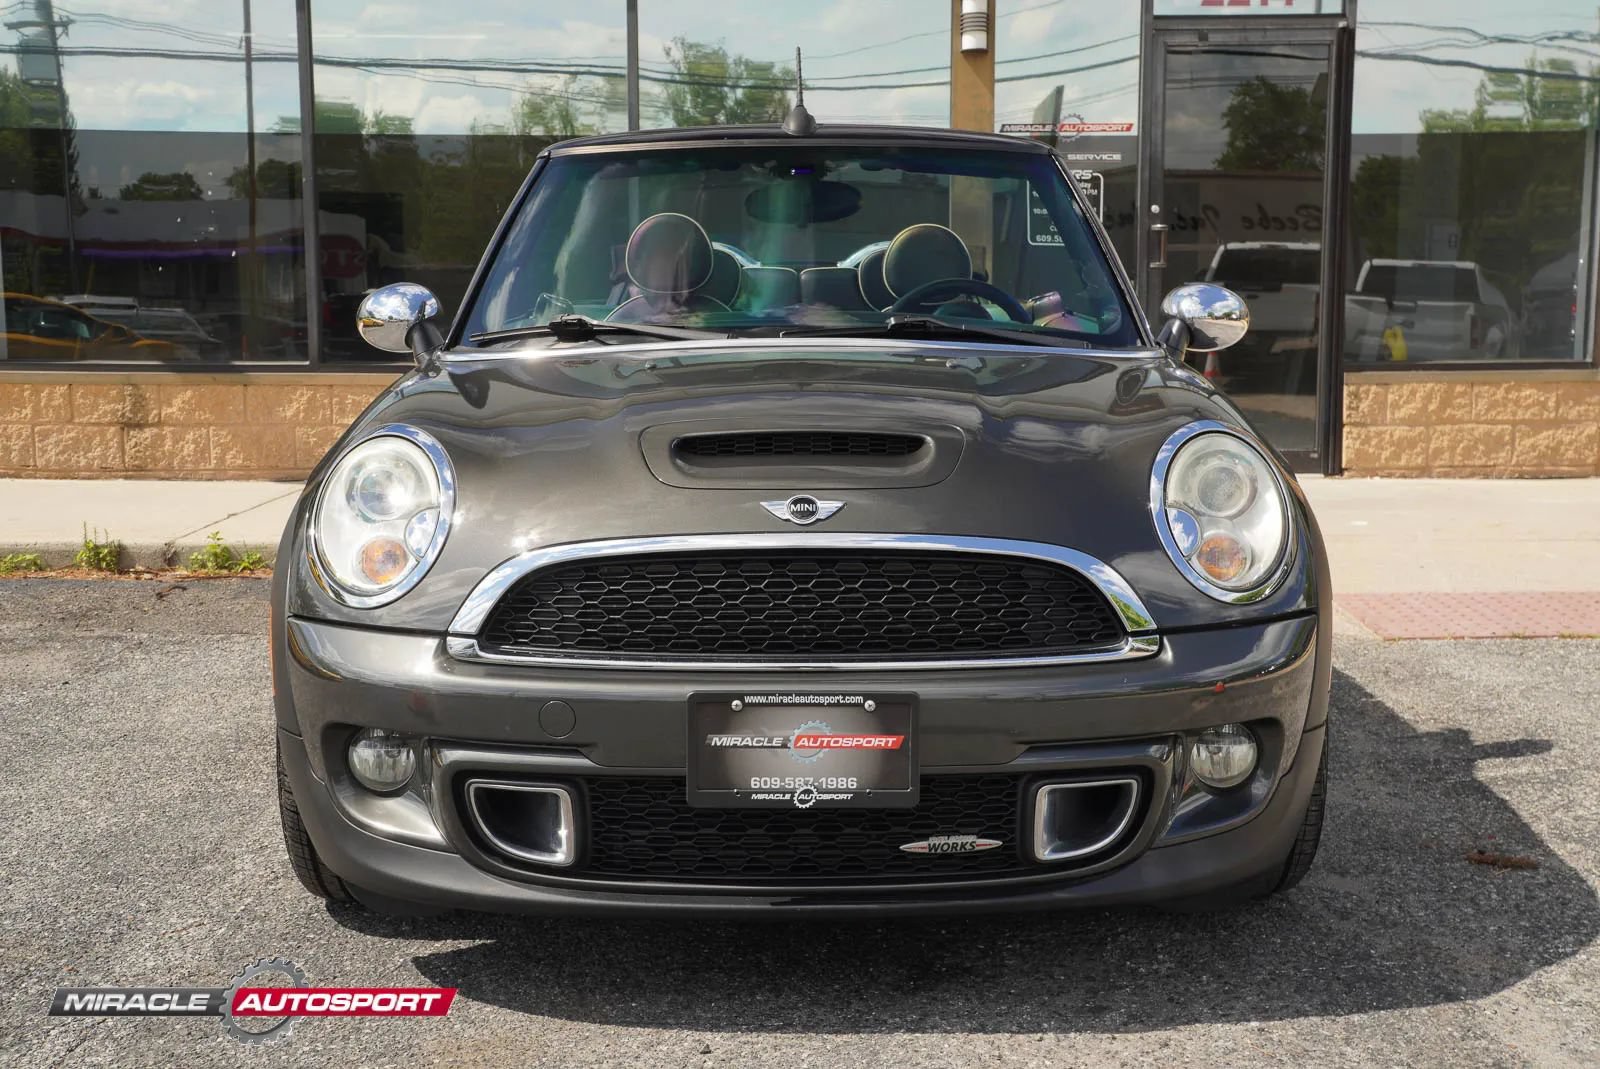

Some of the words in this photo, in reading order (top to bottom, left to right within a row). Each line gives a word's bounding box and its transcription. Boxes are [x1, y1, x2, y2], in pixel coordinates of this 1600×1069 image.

[1060, 123, 1130, 131] AUTOSPORT
[790, 503, 816, 512] MINI
[744, 694, 863, 705] www.miracleautosport.com
[711, 737, 783, 746] MIRACLE
[796, 737, 897, 746] AUTOSPORT
[750, 777, 857, 789] 609-587-1986
[928, 841, 977, 853] WORKS
